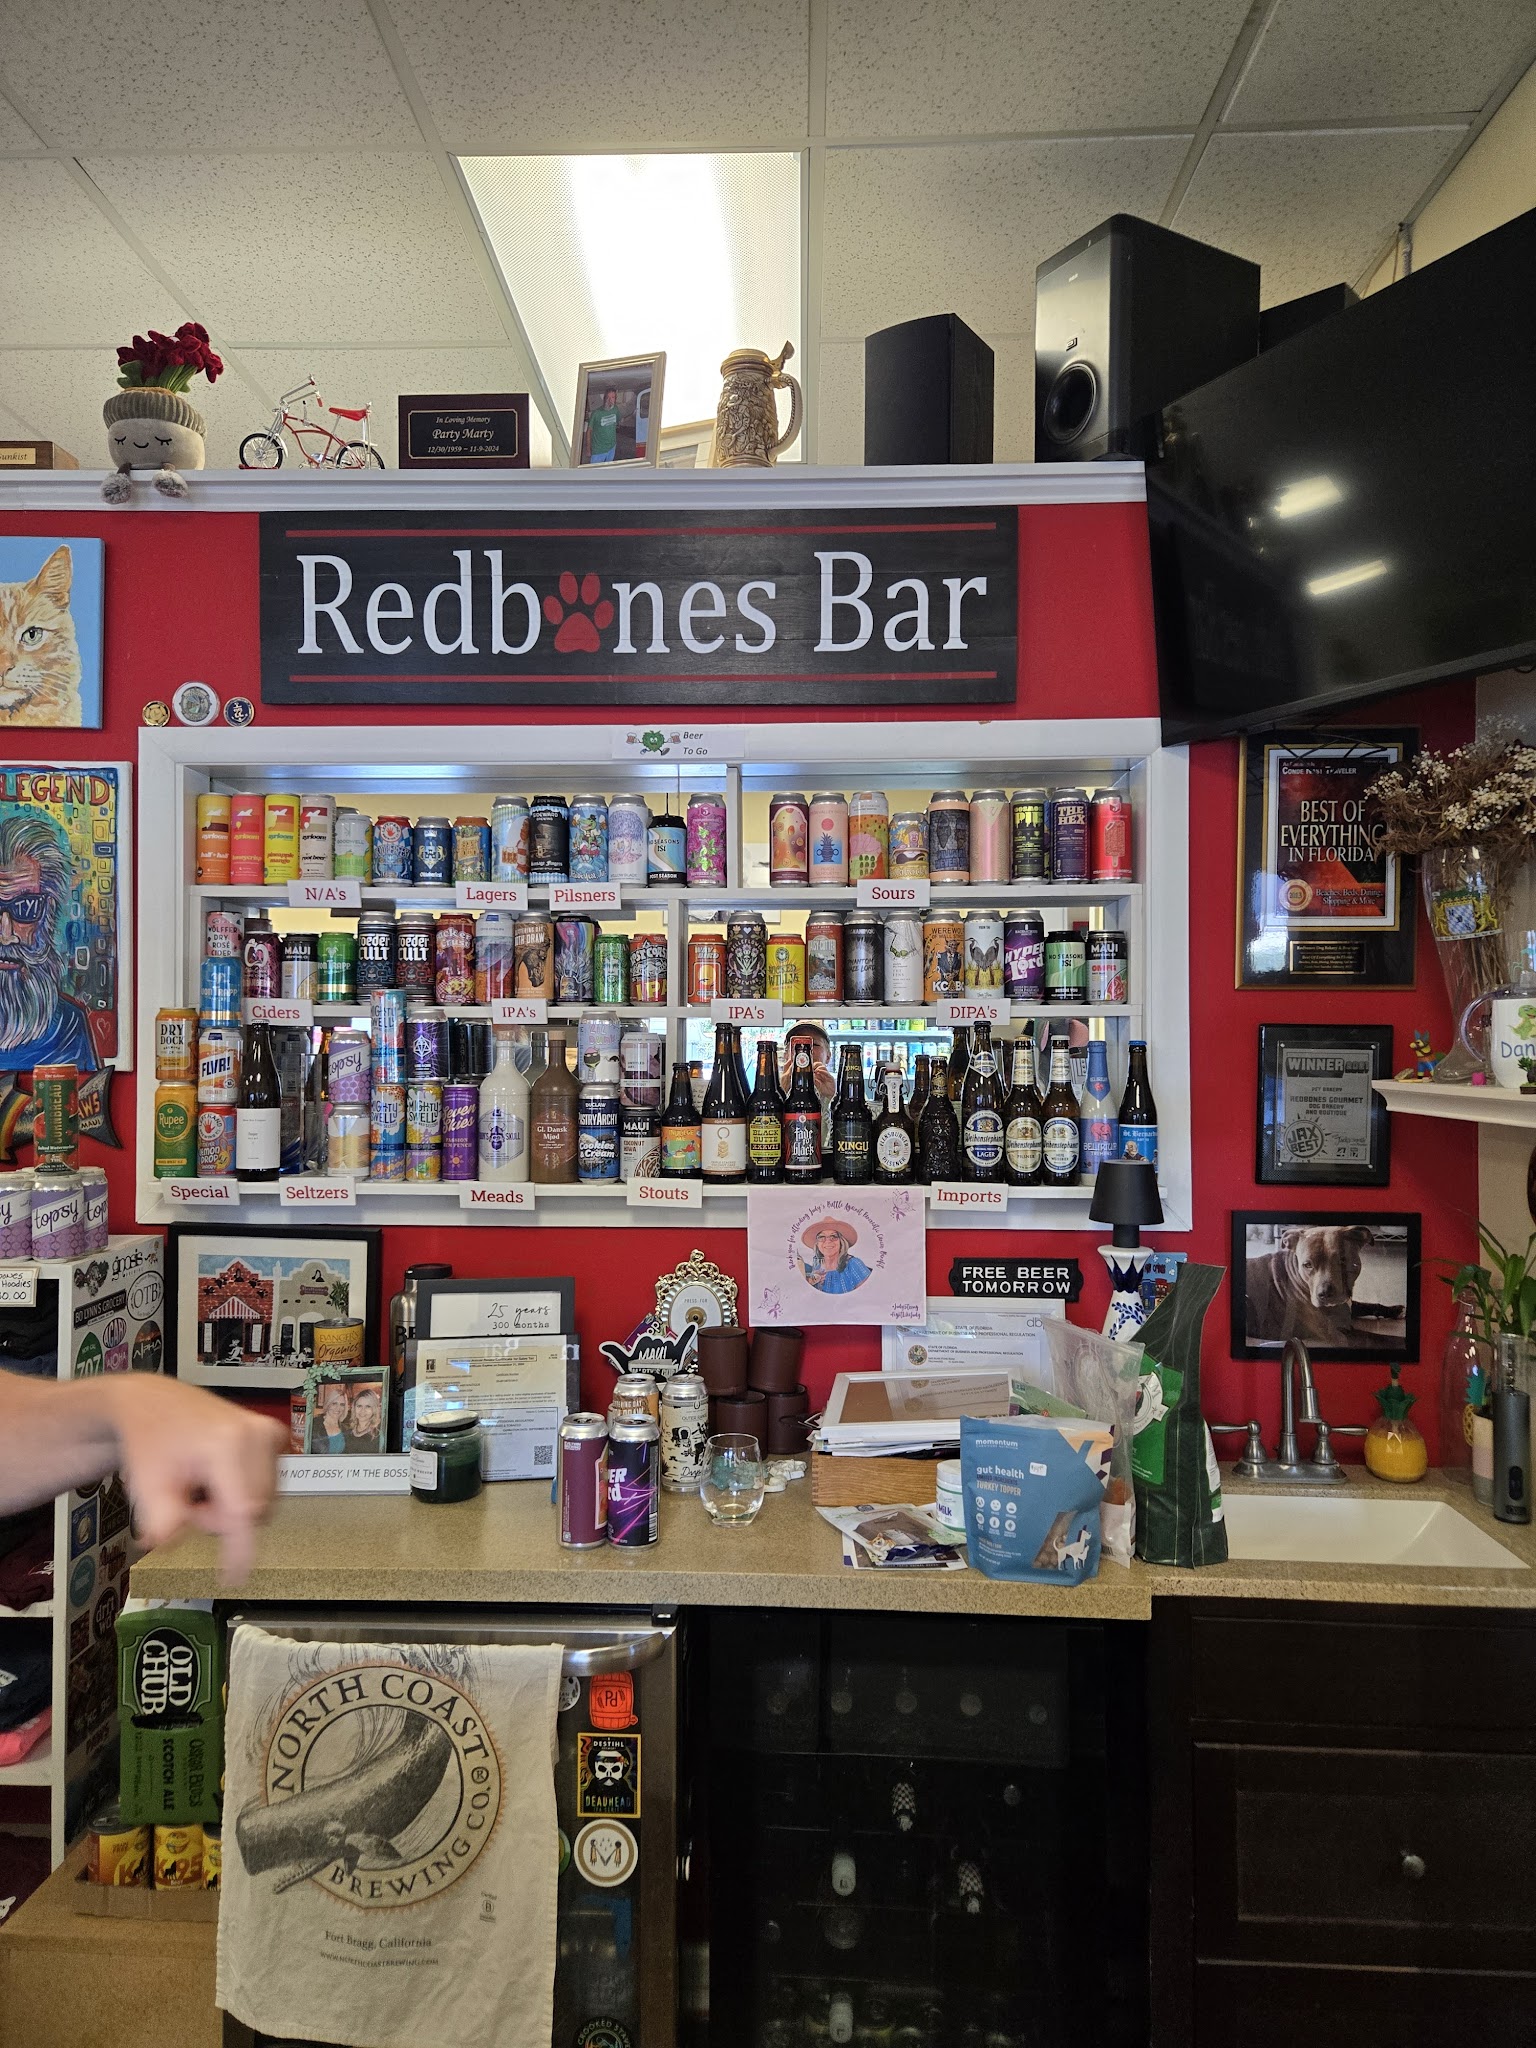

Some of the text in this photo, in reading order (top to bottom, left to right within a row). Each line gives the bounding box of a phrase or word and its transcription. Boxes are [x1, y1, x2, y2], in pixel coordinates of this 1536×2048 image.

[444, 416, 465, 425] Loving
[466, 416, 491, 424] Memory
[432, 428, 494, 441] Party Marty
[813, 551, 987, 653] Bar
[683, 731, 703, 740] Beer
[684, 747, 708, 756] To Go
[0, 773, 110, 805] LEGEND
[1058, 805, 1084, 815] THE
[1301, 800, 1366, 823] BEST OF
[1058, 814, 1086, 825] HEX
[1288, 846, 1375, 862] IN FLORIDA
[305, 887, 347, 900] N/A's
[466, 887, 517, 902] Lagers
[554, 888, 616, 902] Pilsners
[872, 886, 915, 900] Sours
[1322, 897, 1351, 906] Shopping
[212, 941, 231, 949] ROSÉ
[526, 933, 545, 944] DRAW
[284, 946, 311, 955] MAUI
[1005, 942, 1044, 964] HYPER
[1091, 944, 1118, 953] MAUI
[1009, 952, 1044, 981] Lord
[252, 1005, 300, 1019] Ciders
[502, 1006, 537, 1018] IPA's
[729, 1006, 765, 1020] IPA's
[950, 1005, 998, 1019] DIPA's
[160, 1023, 184, 1035] DRY
[160, 1035, 184, 1045] DOCK
[201, 1056, 231, 1078] FLVR!
[845, 1065, 862, 1073] XINGU
[1288, 1057, 1344, 1071] WINNER
[1290, 1095, 1364, 1104] REDBONES GOURMET
[409, 1100, 438, 1118] MIGHTY
[443, 1103, 476, 1120] Seven
[81, 1118, 101, 1129] MAUI
[159, 1113, 185, 1128] Rupee
[443, 1117, 474, 1134] Skies
[624, 1117, 650, 1131] MAUI
[543, 1133, 560, 1141] Mjød
[794, 1126, 814, 1140] fade
[880, 1131, 909, 1147] FLENSBURGER
[1288, 1125, 1317, 1144] JAX
[580, 1141, 615, 1150] Cookies
[792, 1141, 814, 1156] black
[837, 1141, 870, 1151] XINGU
[1290, 1138, 1320, 1153] BEST
[200, 1154, 219, 1164] DROP
[585, 1149, 615, 1158] Cream
[882, 1156, 905, 1167] PILSENER
[171, 1185, 230, 1200] Special
[286, 1186, 349, 1199] Seltzers
[471, 1189, 524, 1203] Meads
[639, 1186, 689, 1200] Stouts
[937, 1188, 1002, 1203] Imports
[34, 1199, 79, 1233] topsy
[962, 1266, 1070, 1279] FREE BEER
[2, 1280, 31, 1288] Hoodies
[962, 1280, 1071, 1294] TOMORROW
[133, 1282, 158, 1309] OTB
[75, 1293, 126, 1323] BO GROCERY
[487, 1302, 550, 1327] 25 years
[492, 1321, 510, 1330] 300
[318, 1342, 360, 1360] Organics
[639, 1346, 668, 1360] MAUI
[106, 1352, 127, 1370] ALOHA
[290, 1468, 410, 1479] NOT BOSSY, I'M THE BOSS.
[977, 1466, 993, 1475] gut
[995, 1465, 1025, 1480] health
[976, 1480, 1022, 1497] TURKEY TOPPER
[938, 1503, 952, 1517] Milk
[141, 1639, 169, 1716] CHUB
[169, 1645, 193, 1706] OLD
[272, 1673, 490, 1792] NORTH COAST
[593, 1740, 625, 1748] DESTIHL
[162, 1738, 175, 1811] SCOTCH ALE
[585, 1794, 632, 1808] DEADHEAD
[330, 1785, 490, 1899] BREWING CO.
[324, 1929, 432, 1951] Fort Bragg, California
[320, 1950, 439, 1967] WWW.NORTHCOASTBREWING.COM
[577, 2018, 612, 2045] CROOKED
